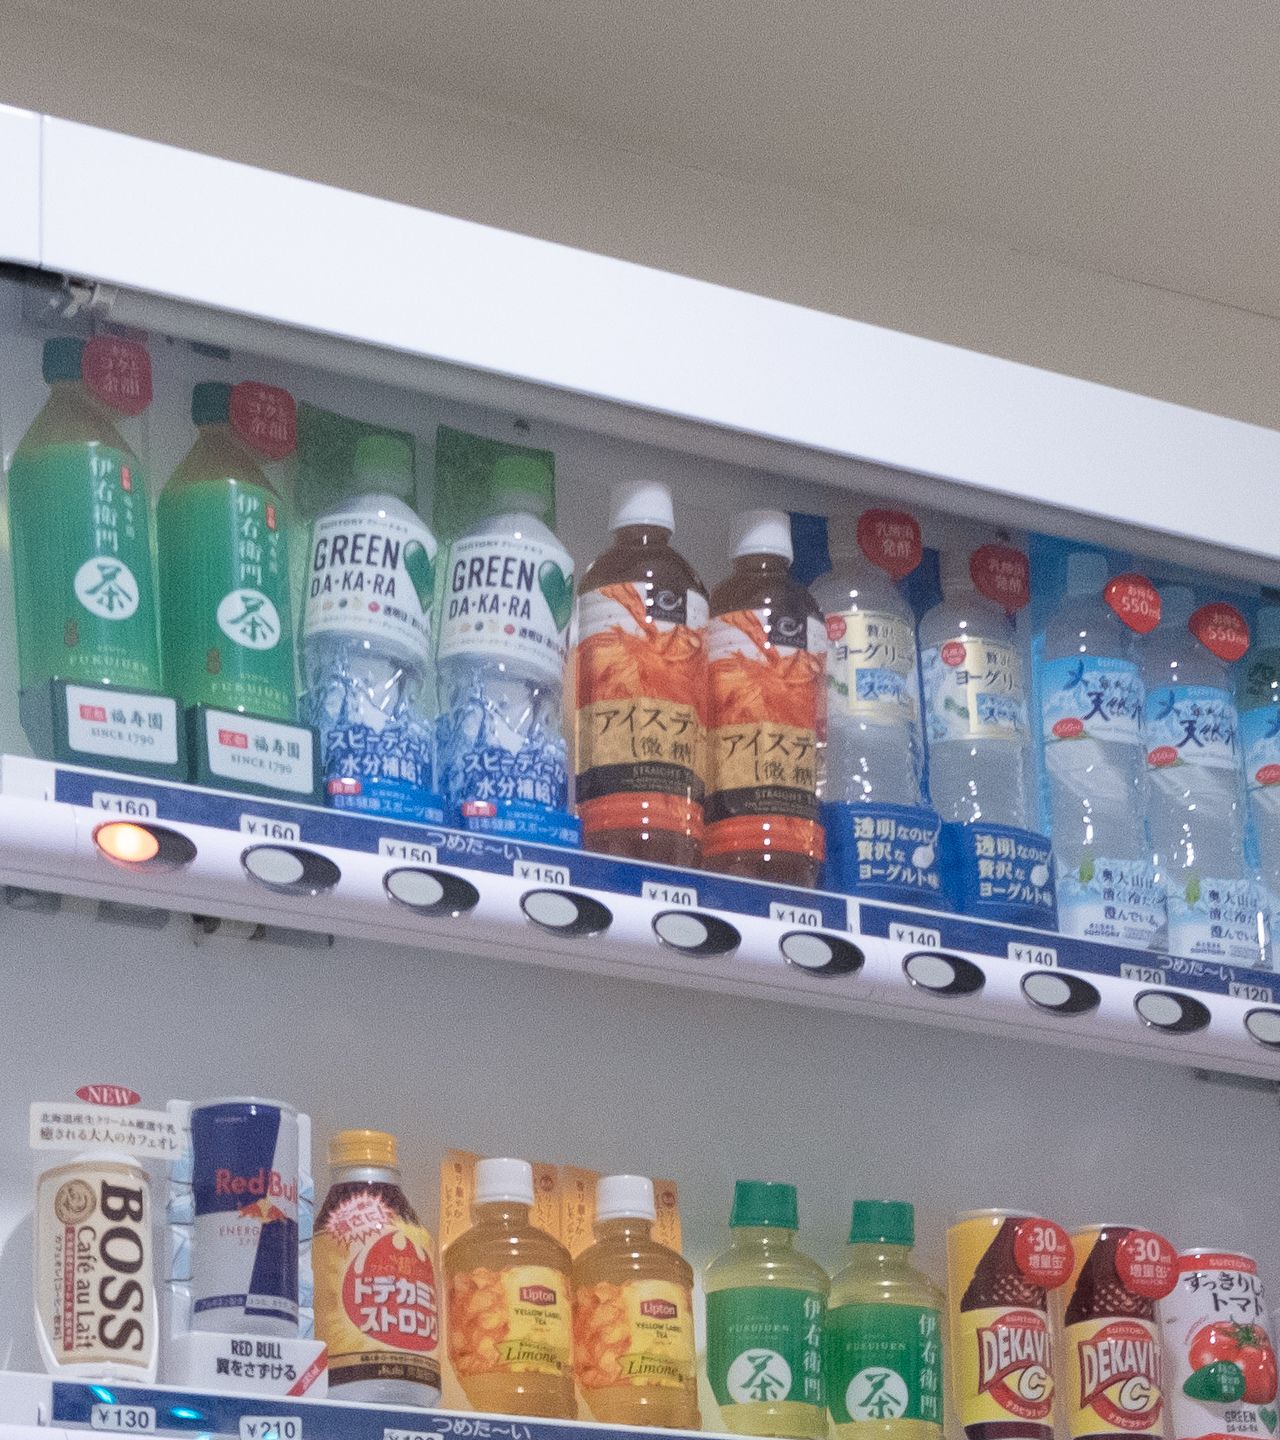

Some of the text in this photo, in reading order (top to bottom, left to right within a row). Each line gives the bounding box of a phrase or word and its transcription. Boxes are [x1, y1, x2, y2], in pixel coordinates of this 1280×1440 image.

[314, 533, 401, 573] GREEN
[452, 555, 536, 593] GREEN
[85, 562, 134, 613] 茶
[226, 596, 276, 644] 茶
[111, 708, 164, 732] 福寿園
[253, 735, 301, 760] 福寿園
[88, 1085, 132, 1105] NEW
[215, 1167, 266, 1195] Red
[98, 1179, 145, 1352] BOSS
[1129, 1263, 1172, 1279] 増量缶
[76, 1225, 98, 1350] Café au Lait
[523, 1288, 555, 1302] Lipton
[643, 1302, 676, 1316] Lipton
[1212, 1292, 1264, 1317] トマト
[534, 1317, 547, 1326] TEA
[656, 1330, 669, 1340] TEA
[231, 1339, 283, 1360] RED BULL
[505, 1346, 557, 1363] Limone
[216, 1357, 298, 1381] 翼をさずける
[628, 1359, 679, 1376] Limone
[740, 1353, 786, 1402] 茶
[857, 1371, 903, 1419] 茶
[1018, 1365, 1048, 1402] C
[1119, 1375, 1152, 1412] C
[97, 1407, 150, 1429] ¥130
[1223, 1409, 1258, 1424] GREEN
[245, 1418, 297, 1440] ¥210
